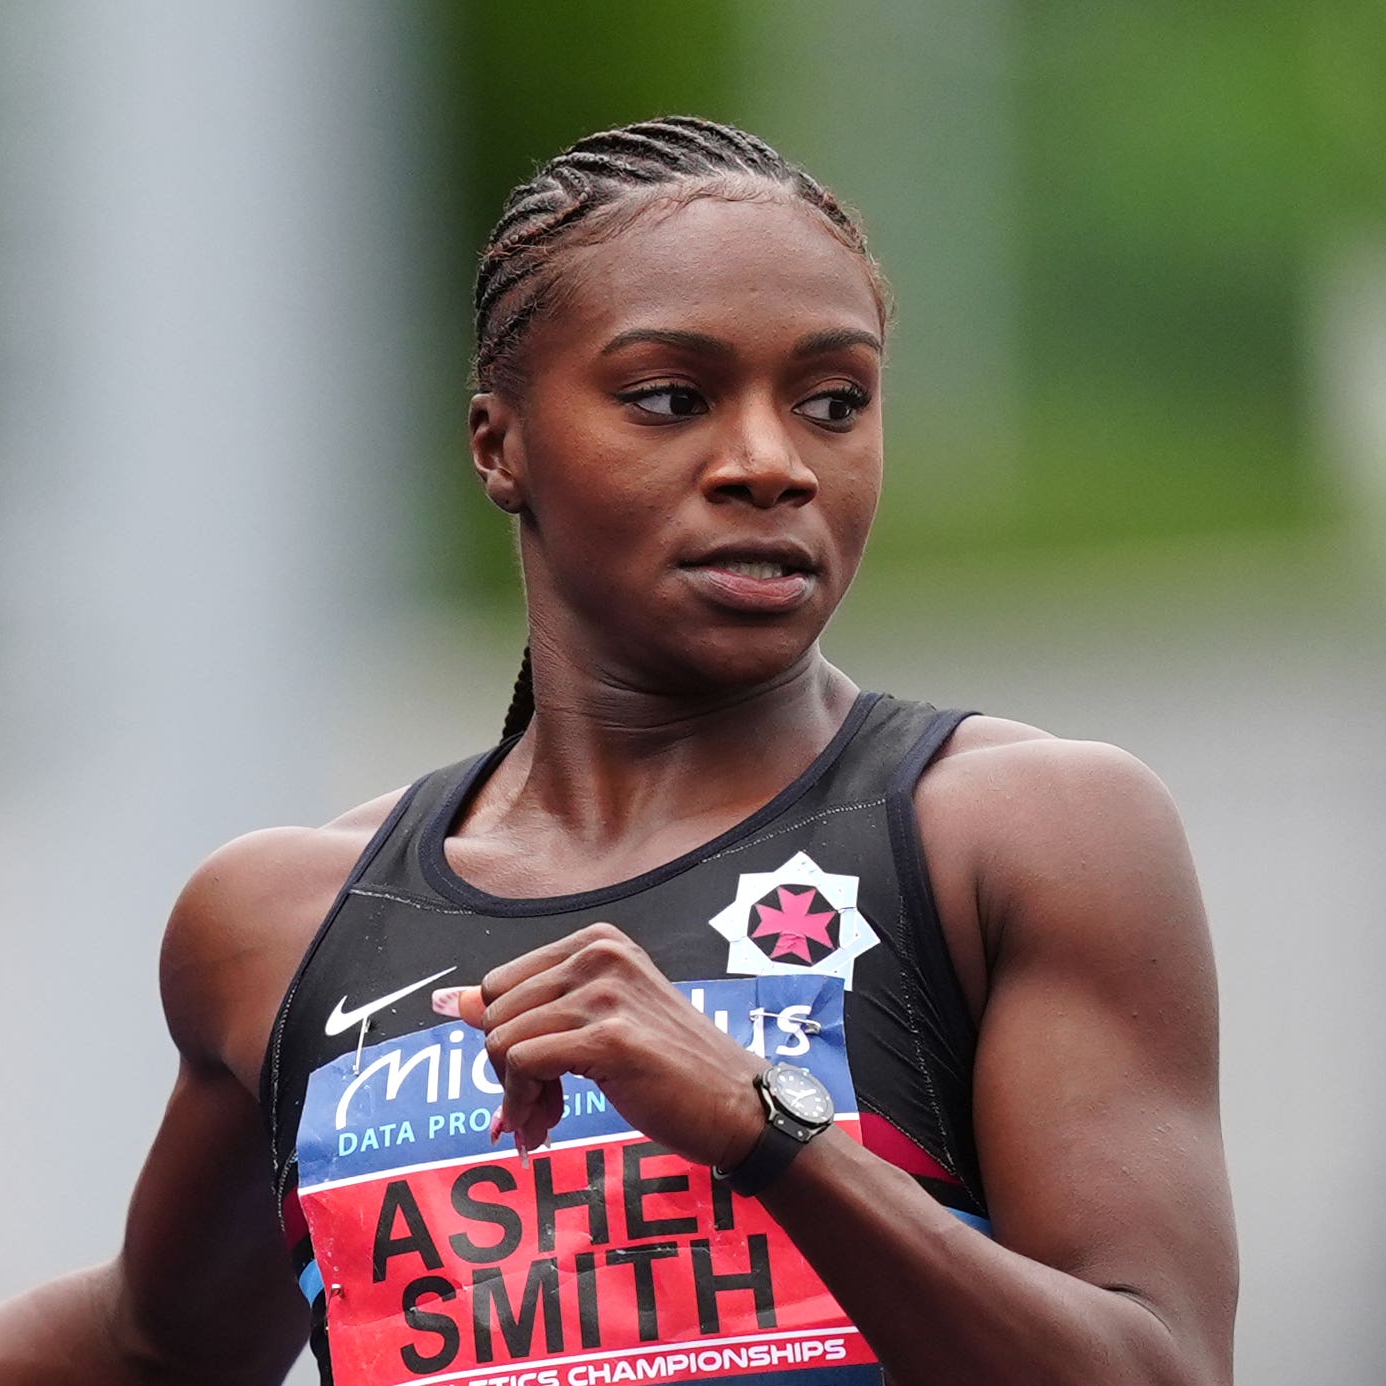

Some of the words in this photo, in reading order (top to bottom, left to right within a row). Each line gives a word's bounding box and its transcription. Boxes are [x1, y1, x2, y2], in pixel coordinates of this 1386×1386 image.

[338, 1121, 415, 1157] DATA
[400, 1233, 778, 1375] SMITH
[567, 1338, 847, 1386] CHAMPIONSHIPS
